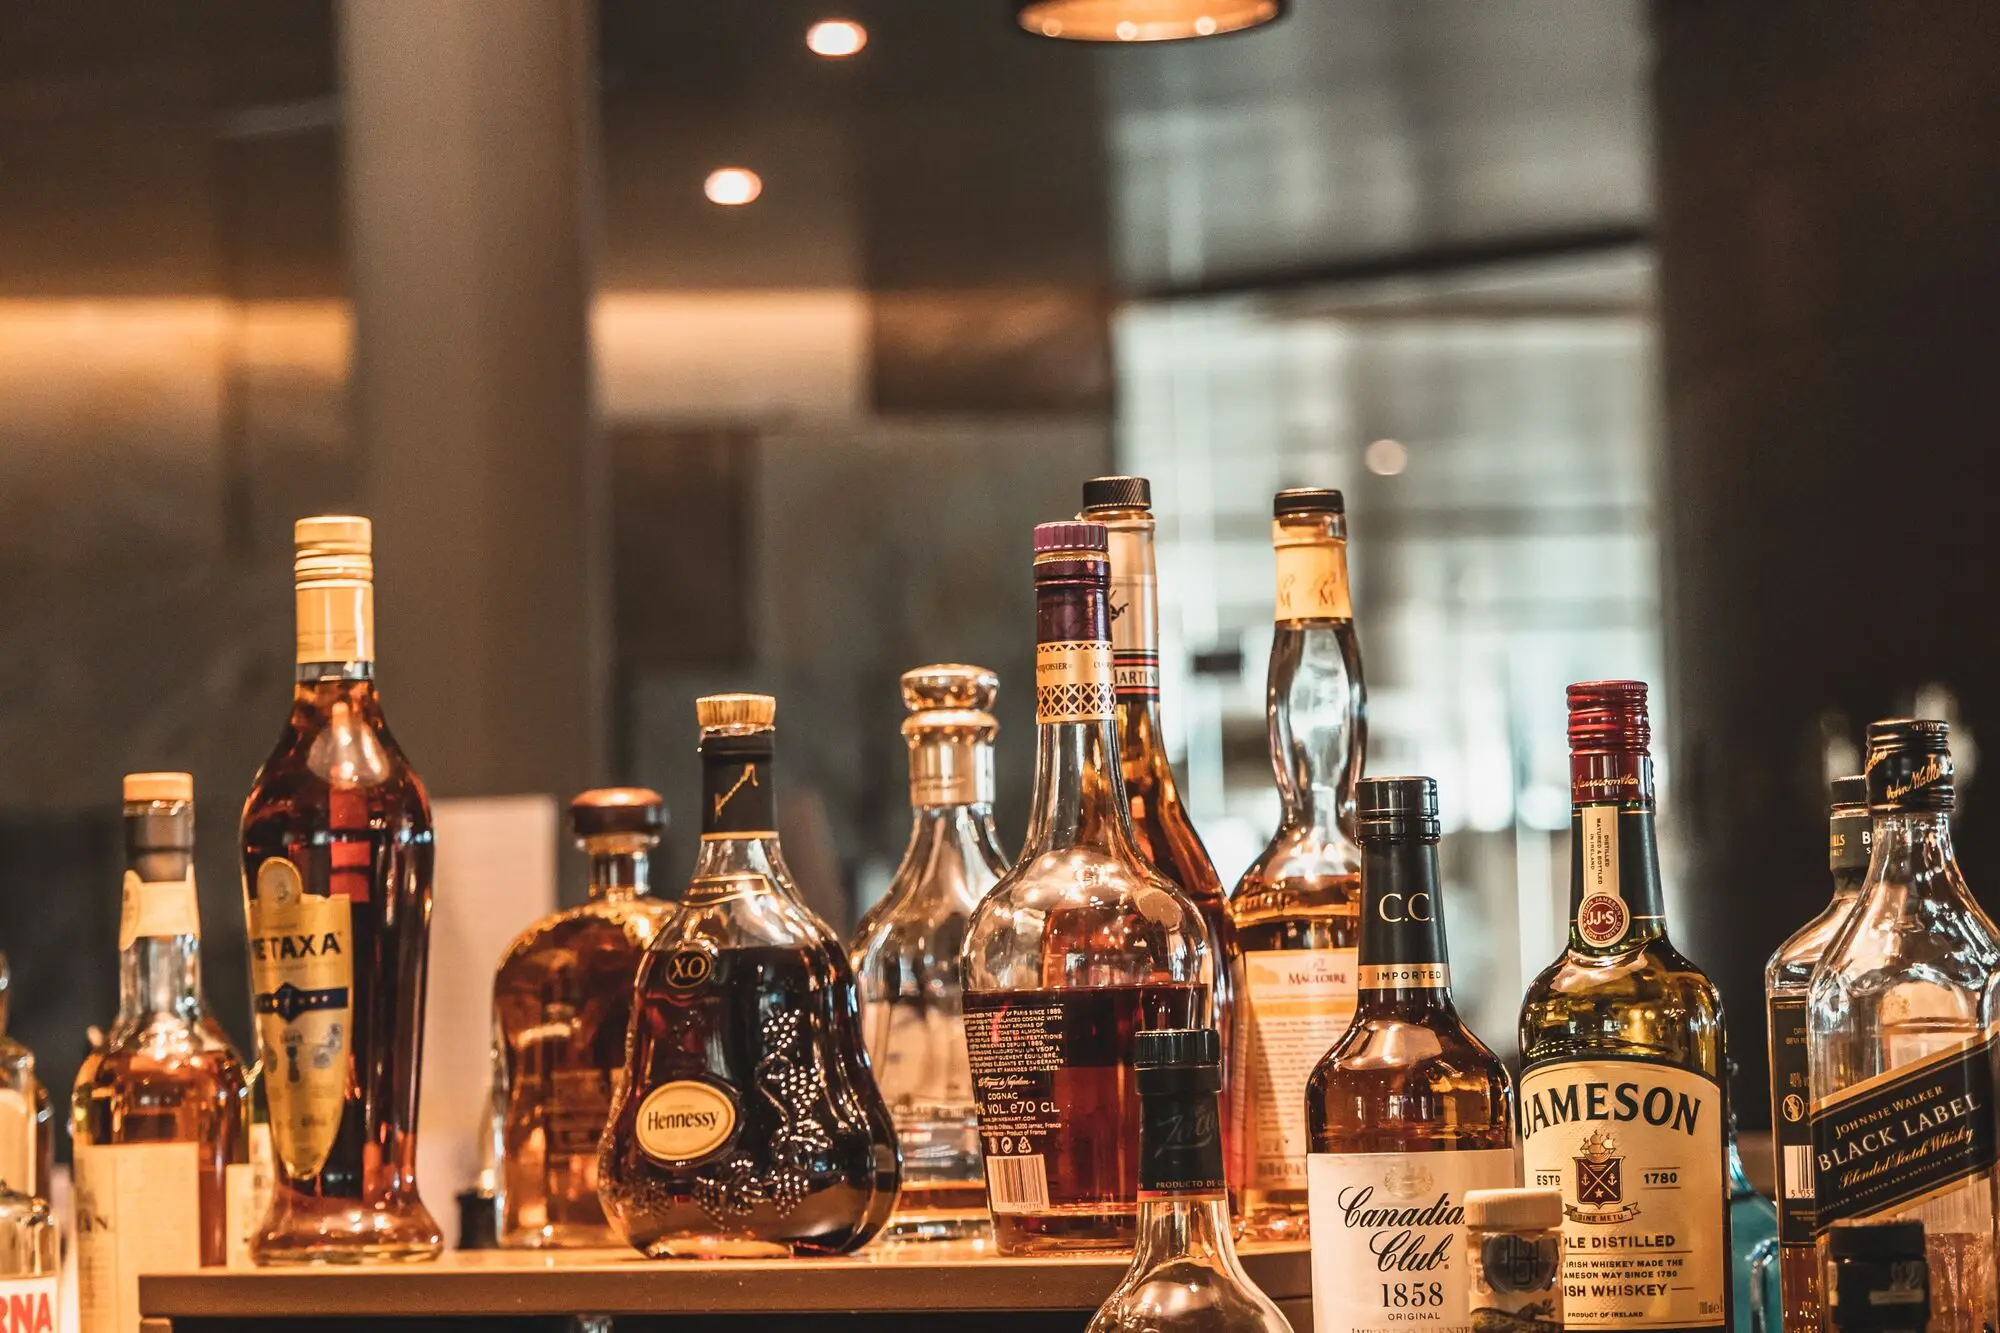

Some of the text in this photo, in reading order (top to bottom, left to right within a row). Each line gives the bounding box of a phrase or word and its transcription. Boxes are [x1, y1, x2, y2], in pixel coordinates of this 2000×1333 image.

[1378, 892, 1435, 922] C.C.
[1583, 896, 1622, 917] JOHN JAMESON
[1586, 928, 1598, 940] SON
[1599, 921, 1622, 940] LIMITED
[252, 932, 342, 960] ETAXA
[1376, 970, 1442, 981] IMPORTED
[987, 1092, 1018, 1100] COGNAC
[1040, 1102, 1060, 1112] CL
[1523, 1082, 1702, 1140] JAMESON
[1834, 1085, 1944, 1140] JOHNNIE WALKER
[648, 1110, 720, 1132] Hennessy
[1818, 1092, 1982, 1172] BLACK LABEL
[1838, 1125, 1975, 1190] Blended Scotch Whisky
[1156, 1180, 1203, 1189] PRODUCTO
[1644, 1172, 1678, 1185] 1780
[1338, 1186, 1465, 1228] Canadia
[1600, 1213, 1623, 1222] METU
[1592, 1235, 1676, 1248] DISTILLED
[1566, 1258, 1684, 1268] IRISH WHISKEY MADE THE
[1381, 1282, 1444, 1308] 1858
[1564, 1284, 1667, 1297] ISH WHISKEY
[1387, 1312, 1441, 1321] ORIGINAL
